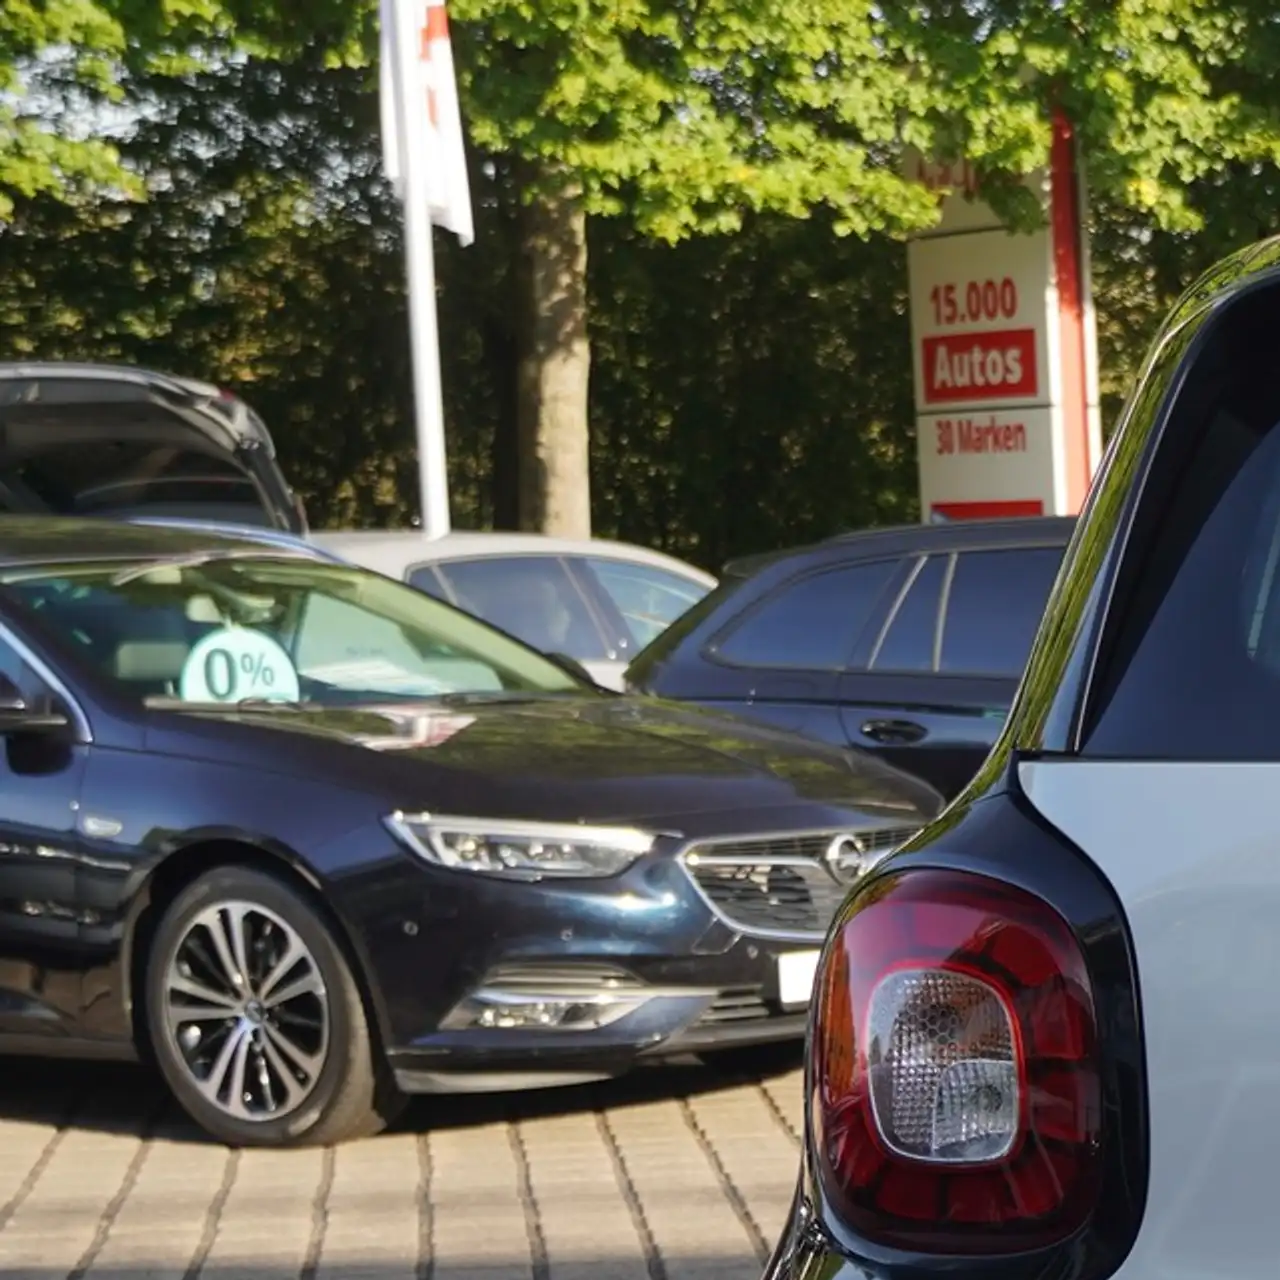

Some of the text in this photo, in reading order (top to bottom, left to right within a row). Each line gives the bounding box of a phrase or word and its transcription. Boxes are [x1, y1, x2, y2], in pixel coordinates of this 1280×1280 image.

[930, 277, 1018, 326] 15.000
[933, 345, 1023, 390] Autos
[935, 416, 1027, 455] 30 Marken
[204, 647, 275, 698] 0%
